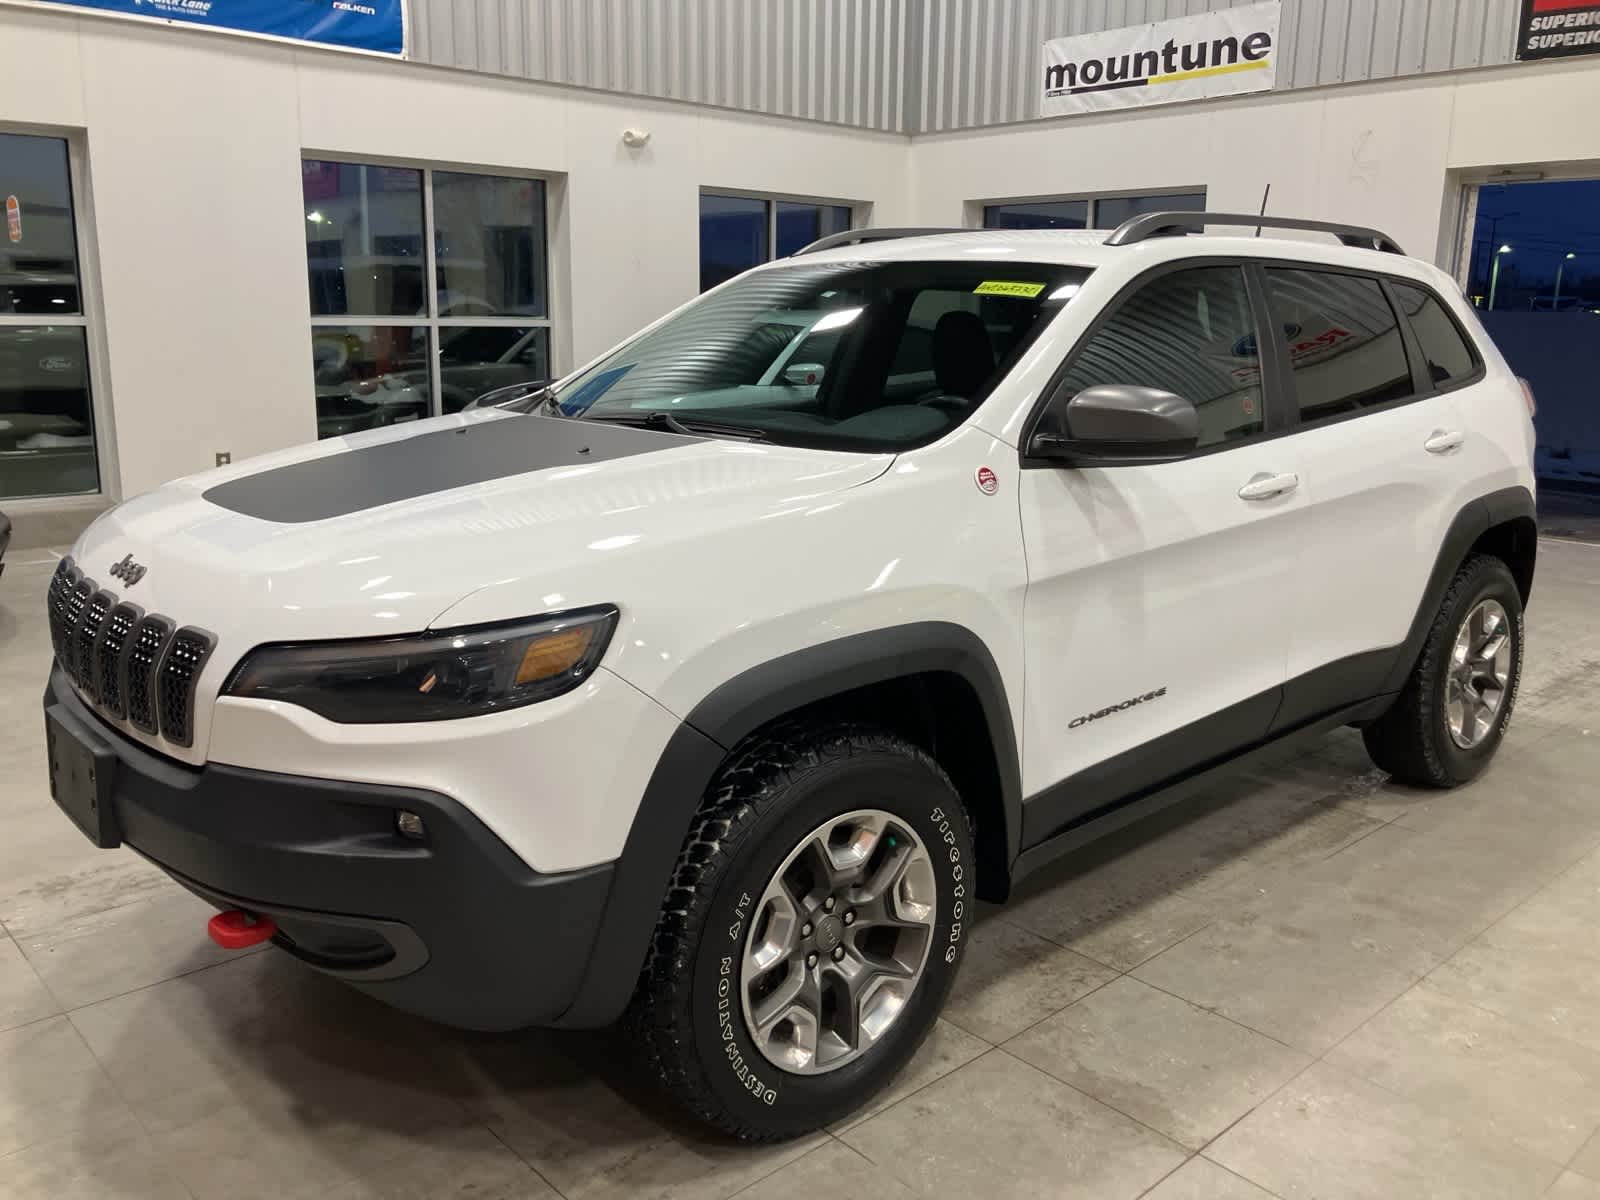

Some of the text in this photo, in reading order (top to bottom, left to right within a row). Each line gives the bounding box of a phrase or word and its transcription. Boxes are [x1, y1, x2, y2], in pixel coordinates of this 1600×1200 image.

[181, 0, 212, 10] Lane
[333, 1, 376, 15] FALKEN
[1046, 31, 1272, 89] mountune
[1067, 686, 1167, 729] CHEROKEE
[718, 892, 777, 1106] DESTINATION A/T
